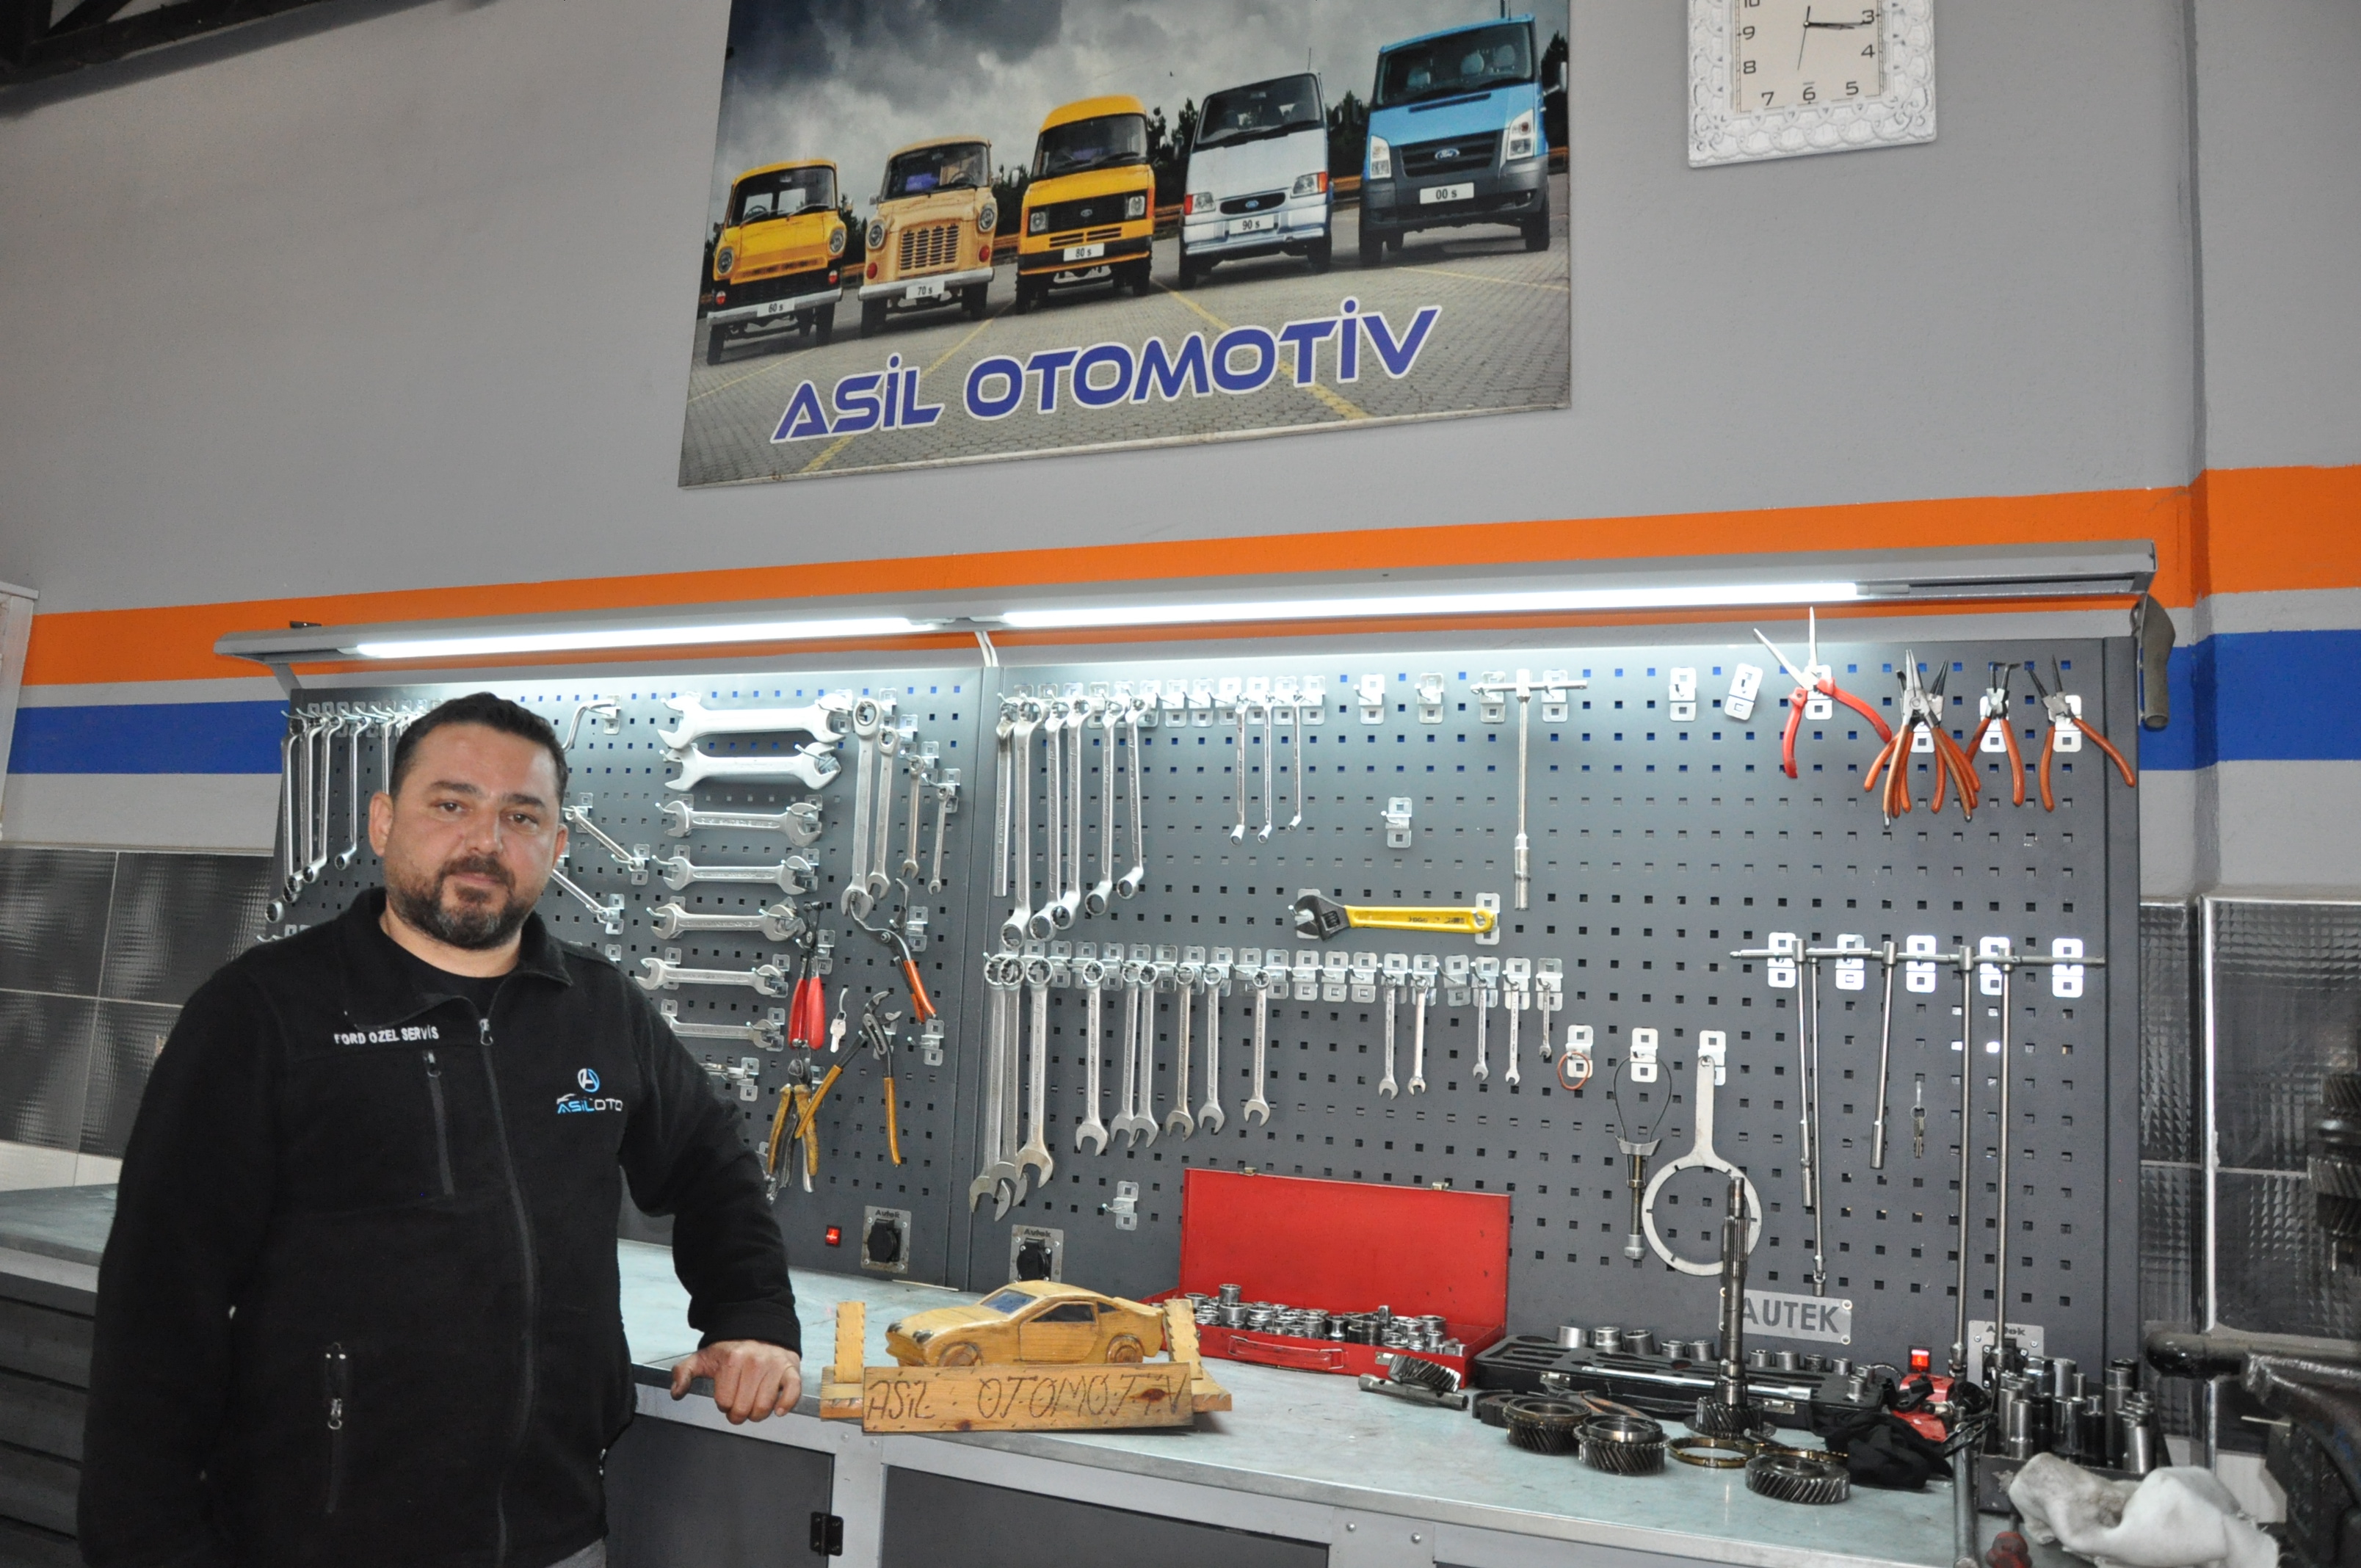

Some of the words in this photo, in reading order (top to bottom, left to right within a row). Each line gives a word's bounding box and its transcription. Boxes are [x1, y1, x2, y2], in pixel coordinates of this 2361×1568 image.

[1862, 10, 1875, 24] 3
[1743, 26, 1755, 40] 9
[1861, 44, 1875, 58] 4
[1744, 60, 1756, 74] 8
[1803, 87, 1816, 101] 6
[1846, 81, 1859, 95] 5
[1761, 91, 1774, 106] 7
[1436, 189, 1448, 200] 00
[1242, 219, 1252, 231] 90
[1076, 248, 1084, 258] 80
[918, 286, 926, 296] 70
[769, 303, 777, 313] 60
[771, 353, 944, 443] ASİL
[964, 296, 1442, 421] OTOMOTİV
[334, 1033, 366, 1045] FORD
[1743, 1297, 1839, 1333] AUTEK
